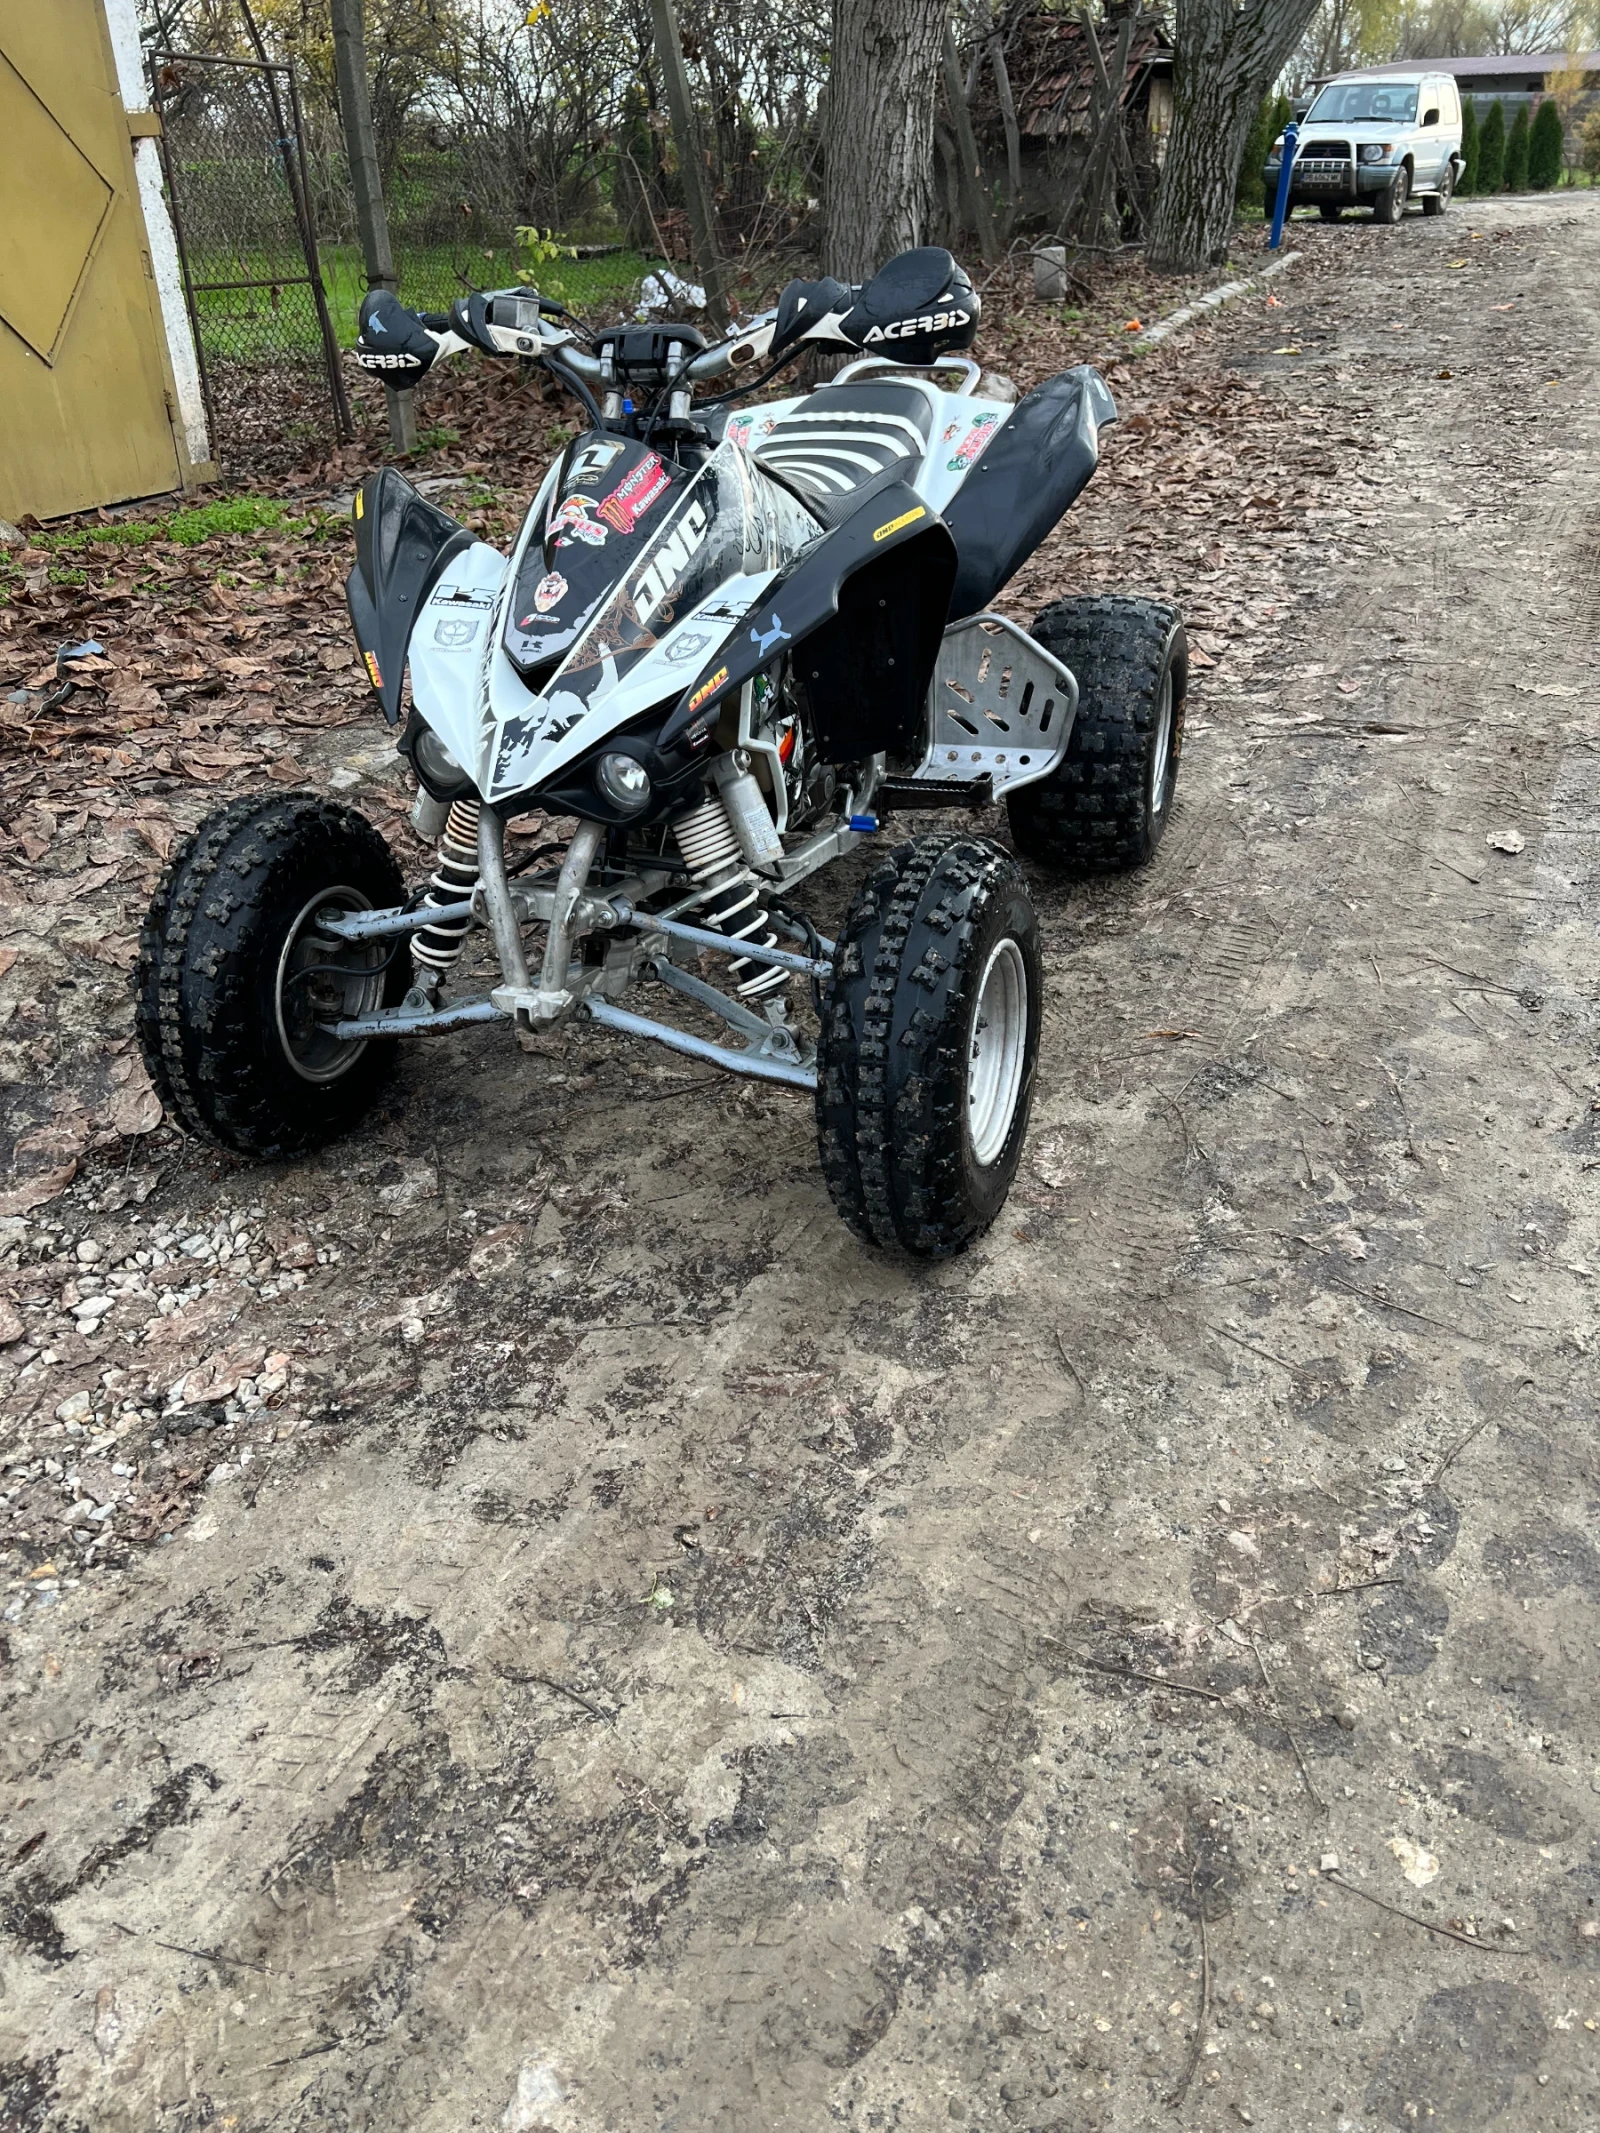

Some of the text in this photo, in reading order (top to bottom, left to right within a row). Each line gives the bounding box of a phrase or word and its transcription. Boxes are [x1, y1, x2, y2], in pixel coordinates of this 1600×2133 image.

[862, 309, 970, 343] ACERBIS
[616, 455, 659, 500] MONSTER
[632, 472, 669, 515] Kawasaki
[431, 598, 491, 609] Kawasaki
